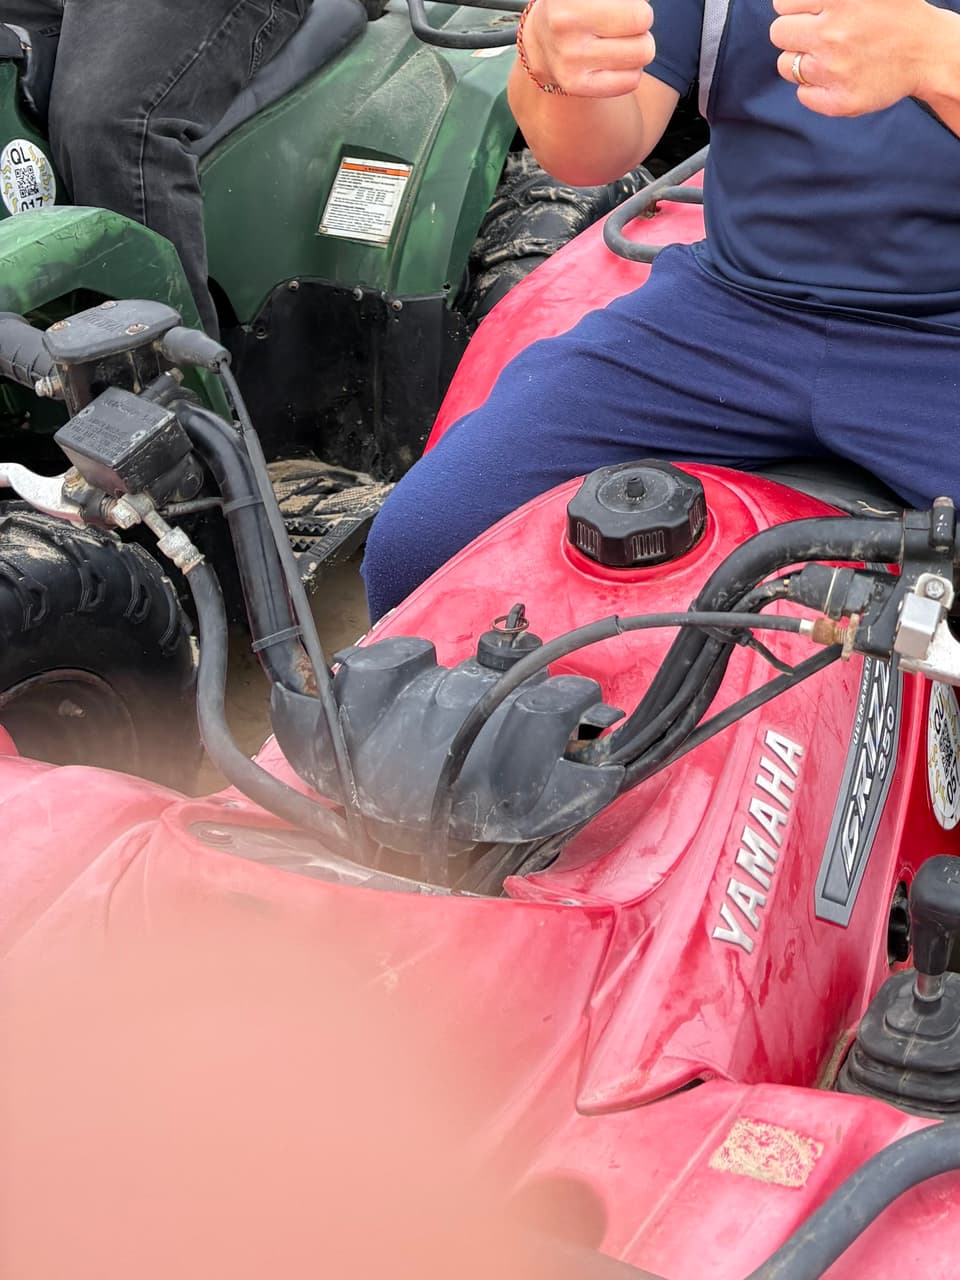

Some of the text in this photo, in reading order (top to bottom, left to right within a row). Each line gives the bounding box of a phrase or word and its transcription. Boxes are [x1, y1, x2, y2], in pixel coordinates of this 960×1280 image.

[711, 729, 804, 955] YAMAHA
[842, 658, 890, 884] GRIZZ
[877, 705, 896, 781] 350
